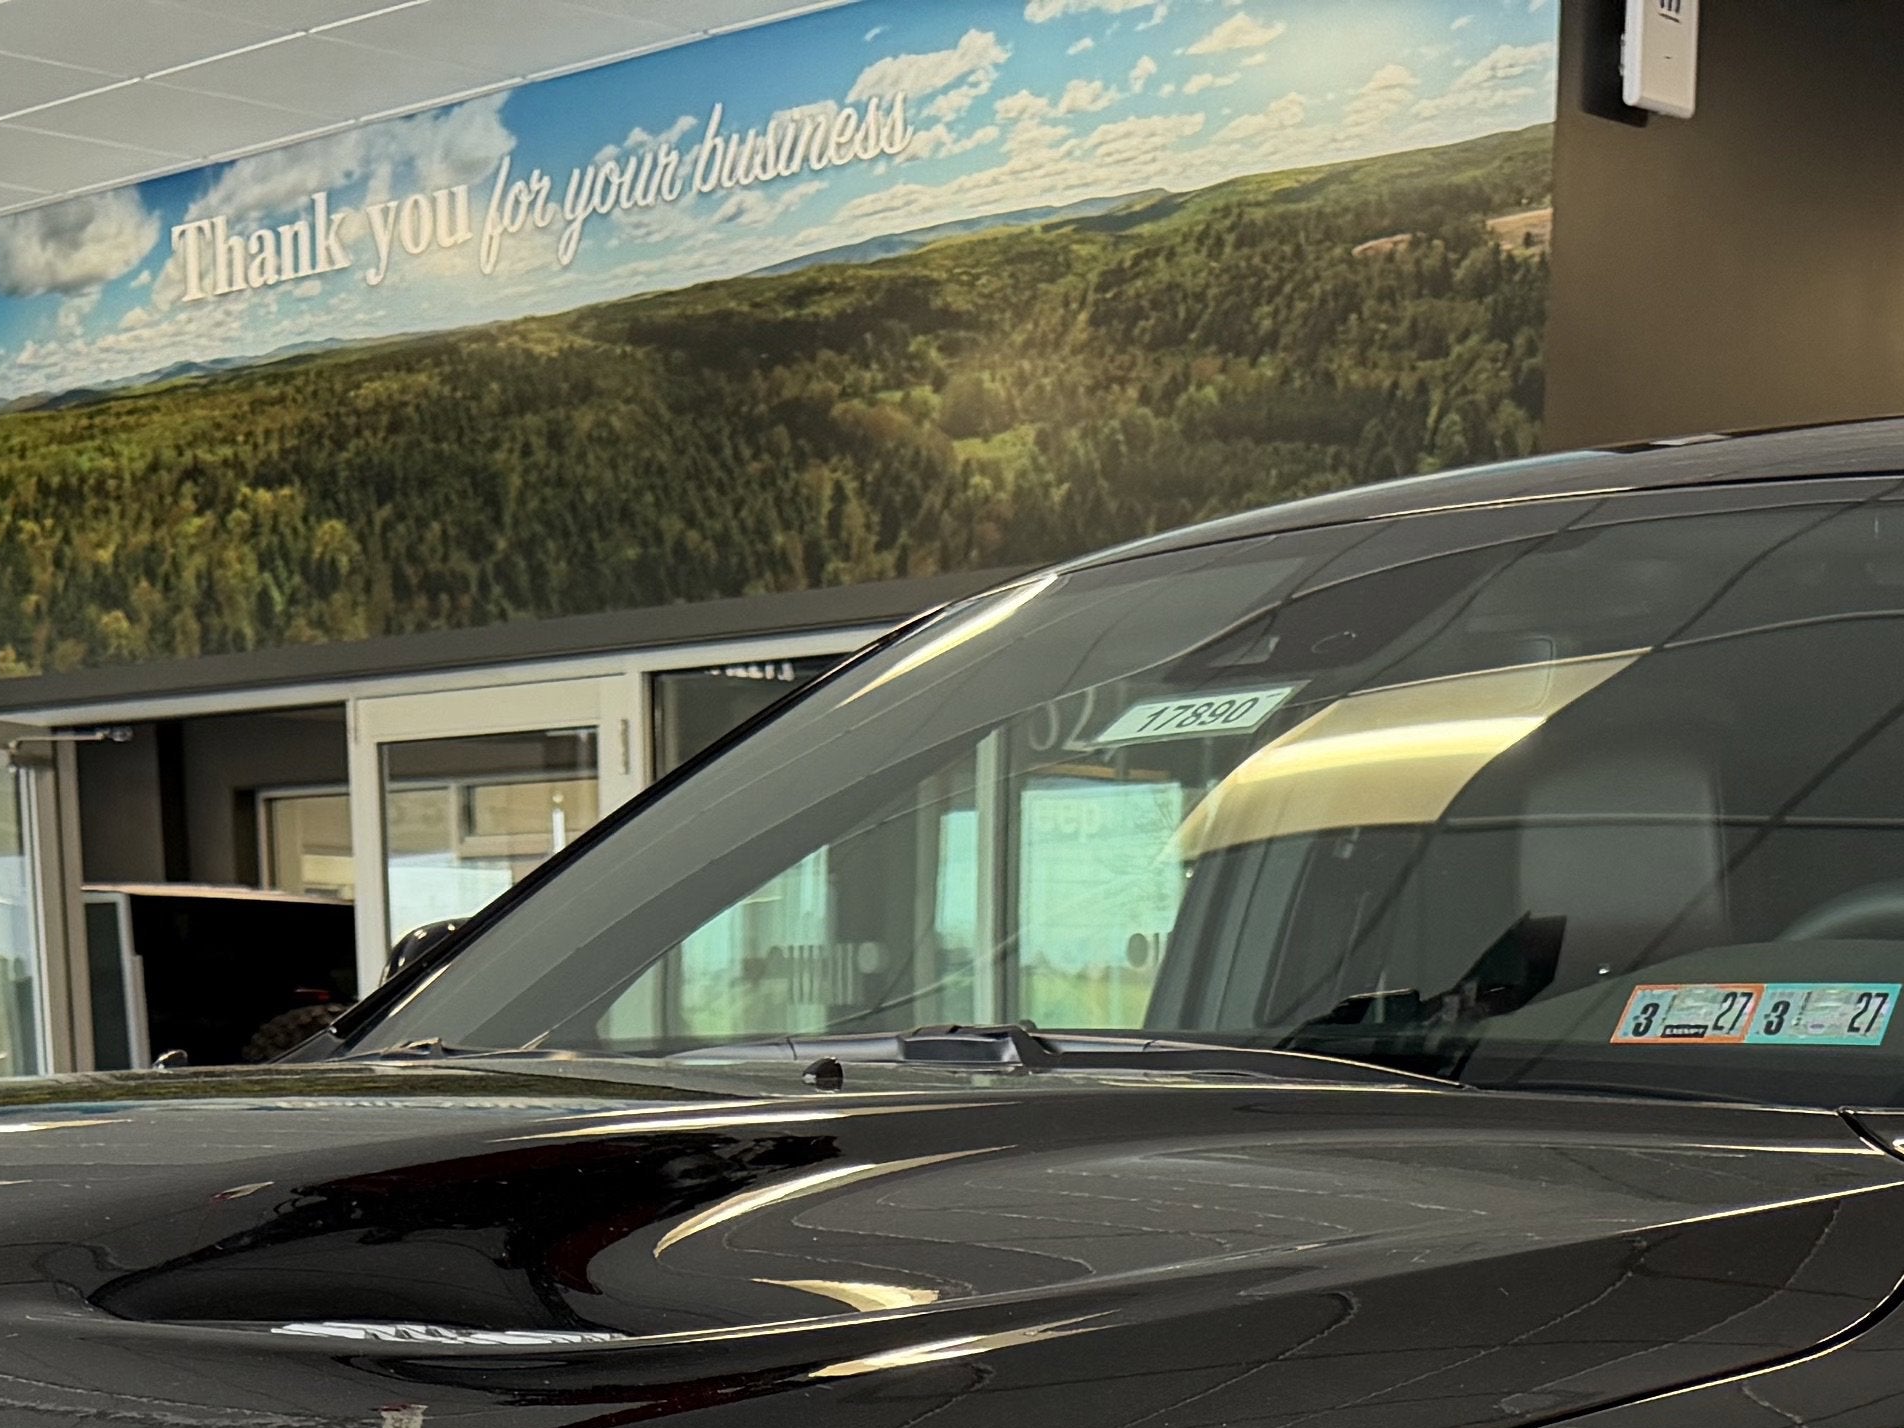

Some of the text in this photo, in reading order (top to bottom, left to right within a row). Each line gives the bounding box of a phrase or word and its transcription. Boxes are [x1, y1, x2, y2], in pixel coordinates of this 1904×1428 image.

[171, 91, 914, 304] Thank you for your business
[1136, 695, 1260, 734] 17890
[1632, 991, 1753, 1037] 3 27
[1763, 992, 1889, 1036] 3 27
